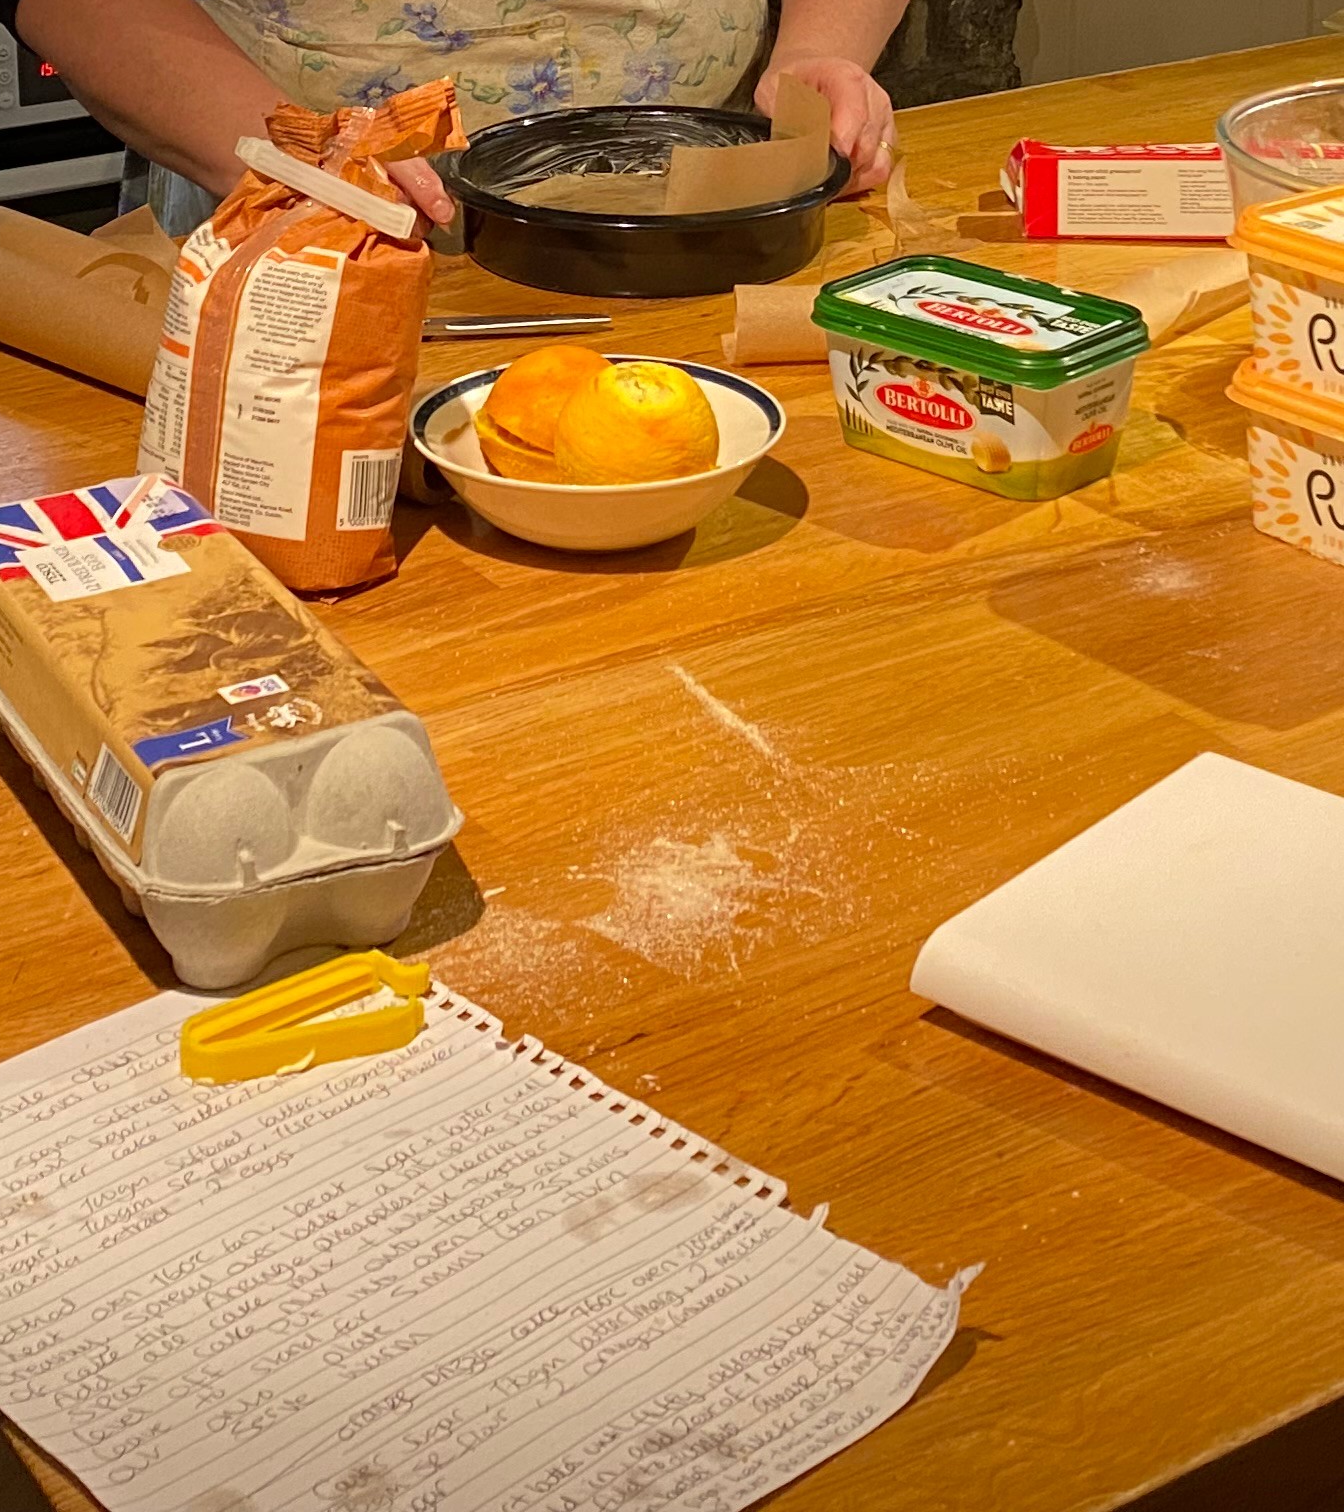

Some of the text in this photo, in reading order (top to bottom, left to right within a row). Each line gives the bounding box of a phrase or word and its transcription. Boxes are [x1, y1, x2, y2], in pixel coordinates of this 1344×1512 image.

[925, 301, 1029, 336] BERTOLLI
[1049, 320, 1094, 335] TASTE
[884, 387, 968, 428] BERTOLLI
[981, 393, 1013, 417] TASTE
[70, 1050, 140, 1083] down
[111, 1134, 158, 1159] cake
[239, 1150, 296, 1178] eggs
[434, 1181, 525, 1228] topping
[836, 1262, 871, 1294] add
[122, 1273, 214, 1320] spread
[53, 1373, 112, 1410] Add
